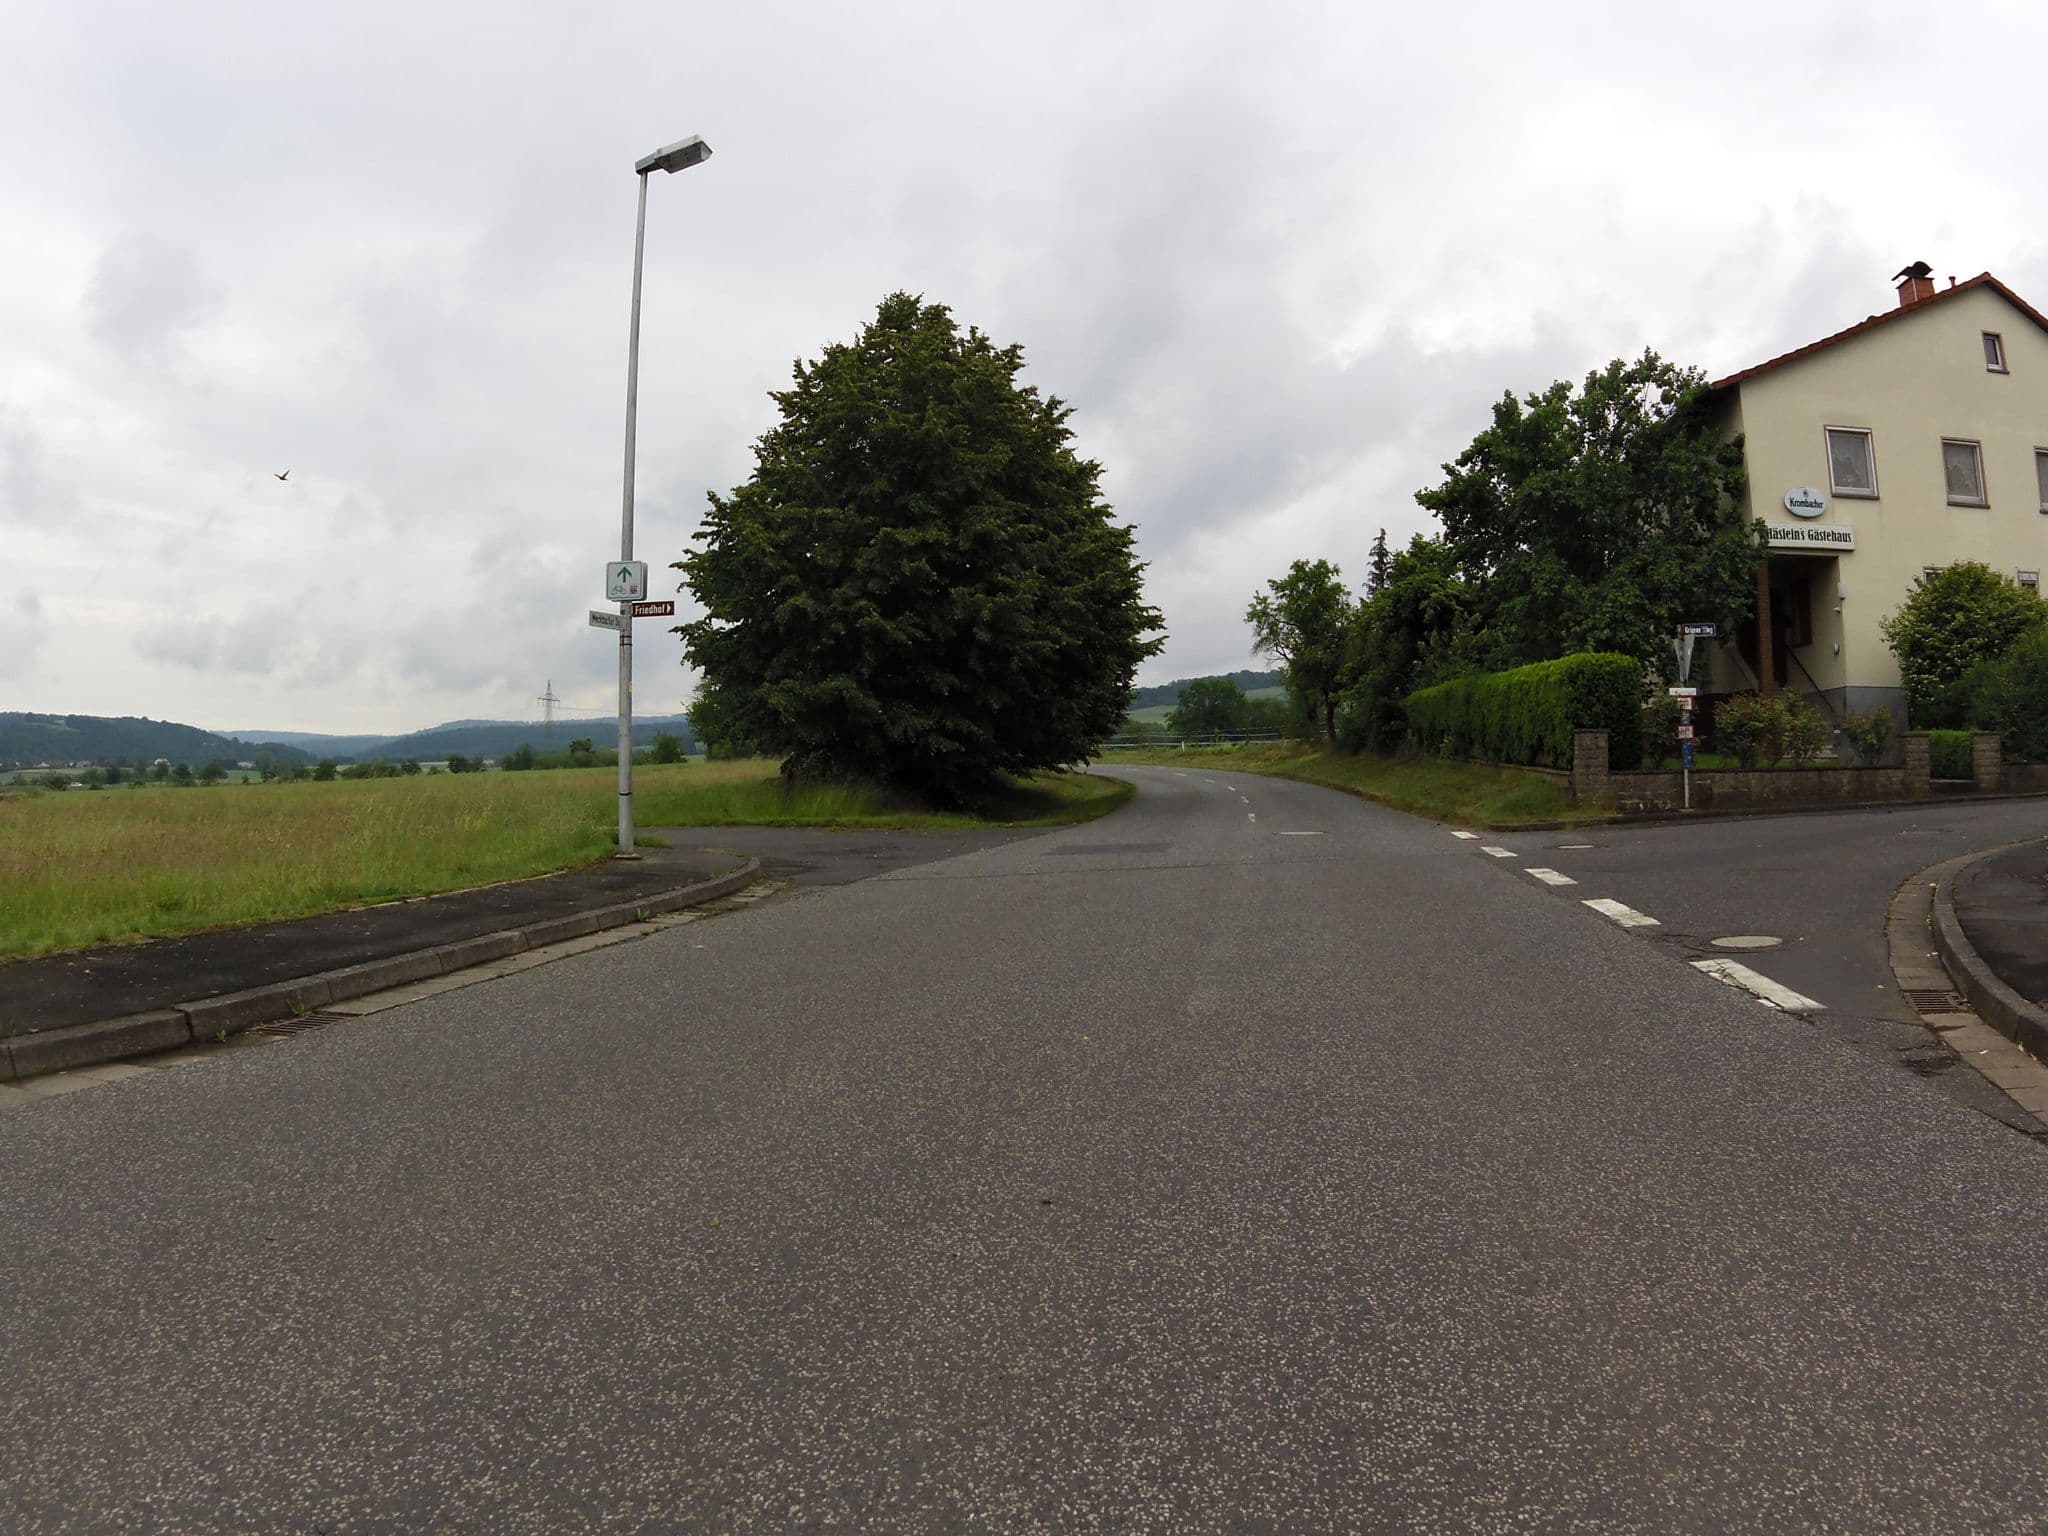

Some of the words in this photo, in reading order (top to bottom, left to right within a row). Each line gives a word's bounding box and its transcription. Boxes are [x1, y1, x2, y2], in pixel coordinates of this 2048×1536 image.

[1789, 498, 1824, 509] Krombacher
[1807, 528, 1852, 543] Gästehaus
[634, 604, 665, 615] Friedhof
